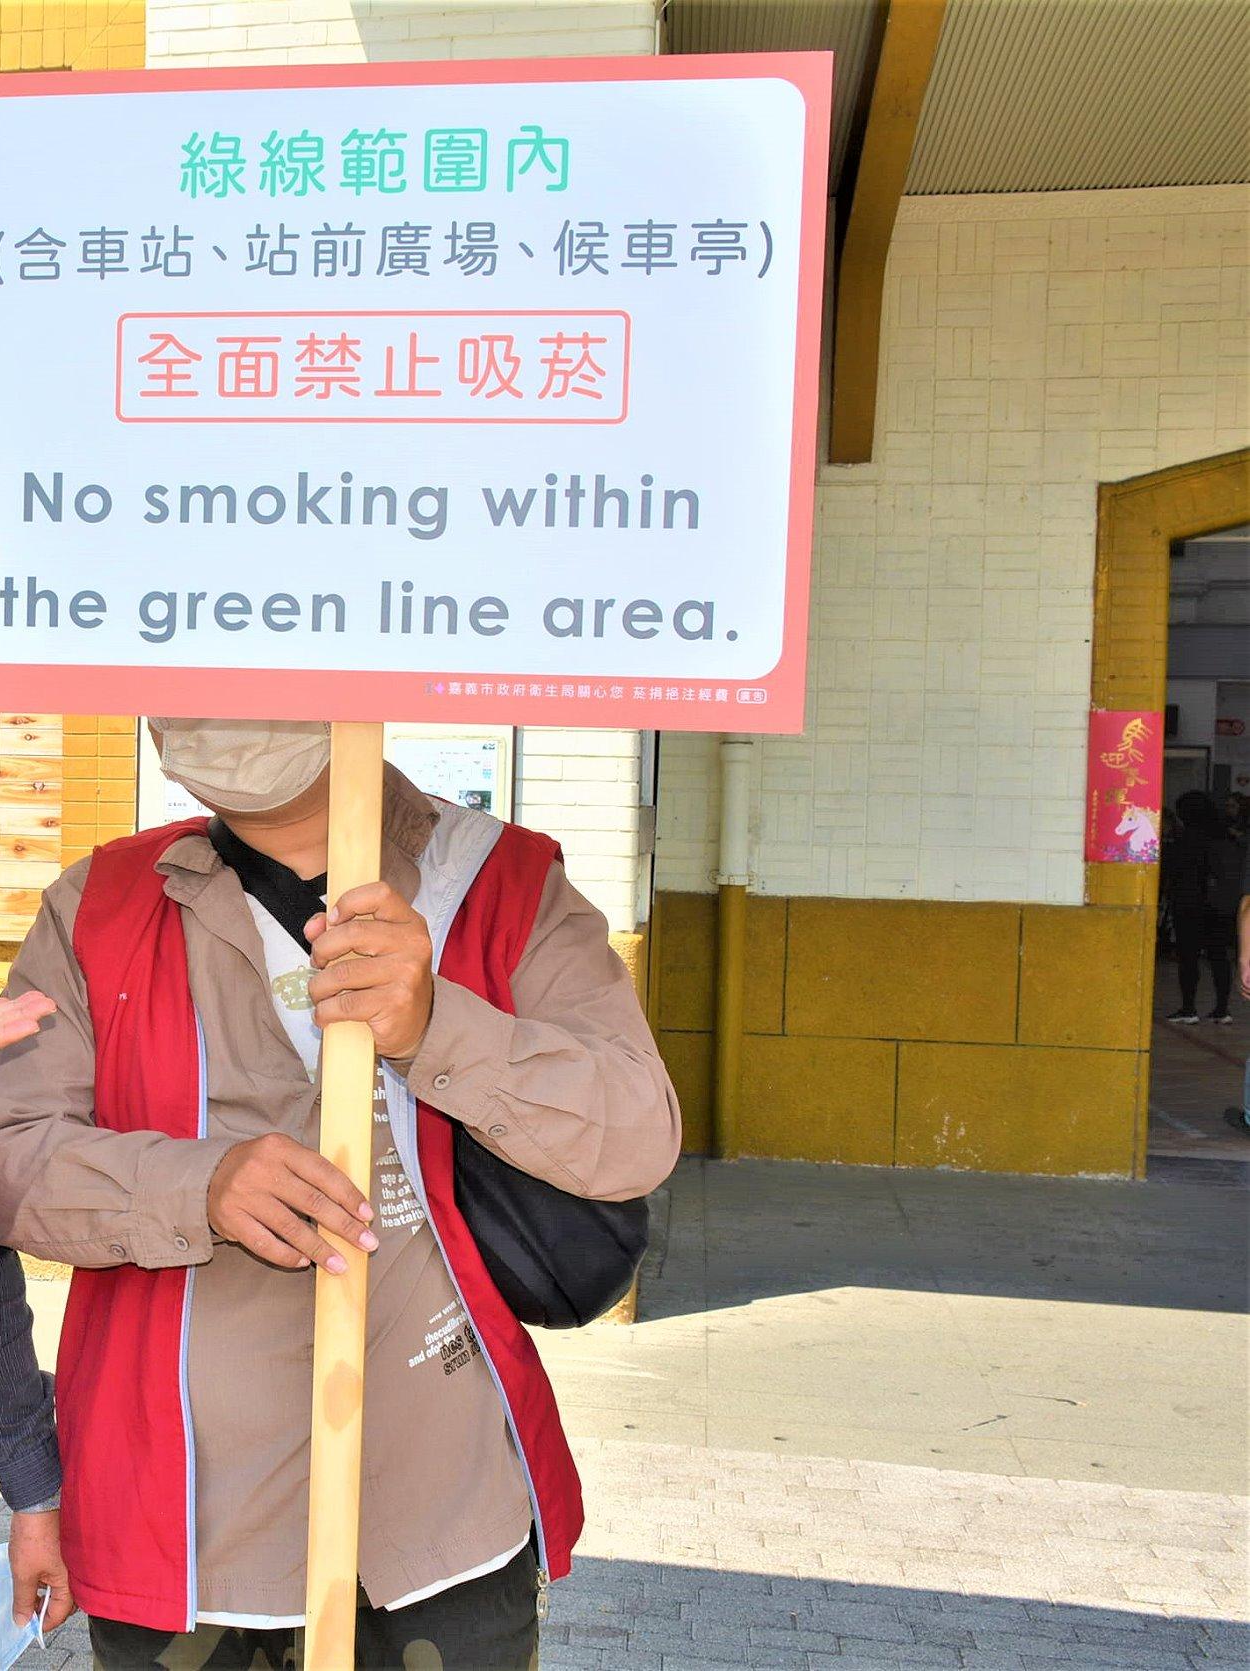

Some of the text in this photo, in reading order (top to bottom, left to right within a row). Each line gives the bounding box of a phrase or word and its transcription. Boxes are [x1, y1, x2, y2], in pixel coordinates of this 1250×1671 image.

[180, 125, 570, 199] 綠線範圍內
[137, 332, 608, 401] 全面禁止吸菸
[23, 472, 700, 540] No smoking within
[0, 576, 739, 643] the green line area.
